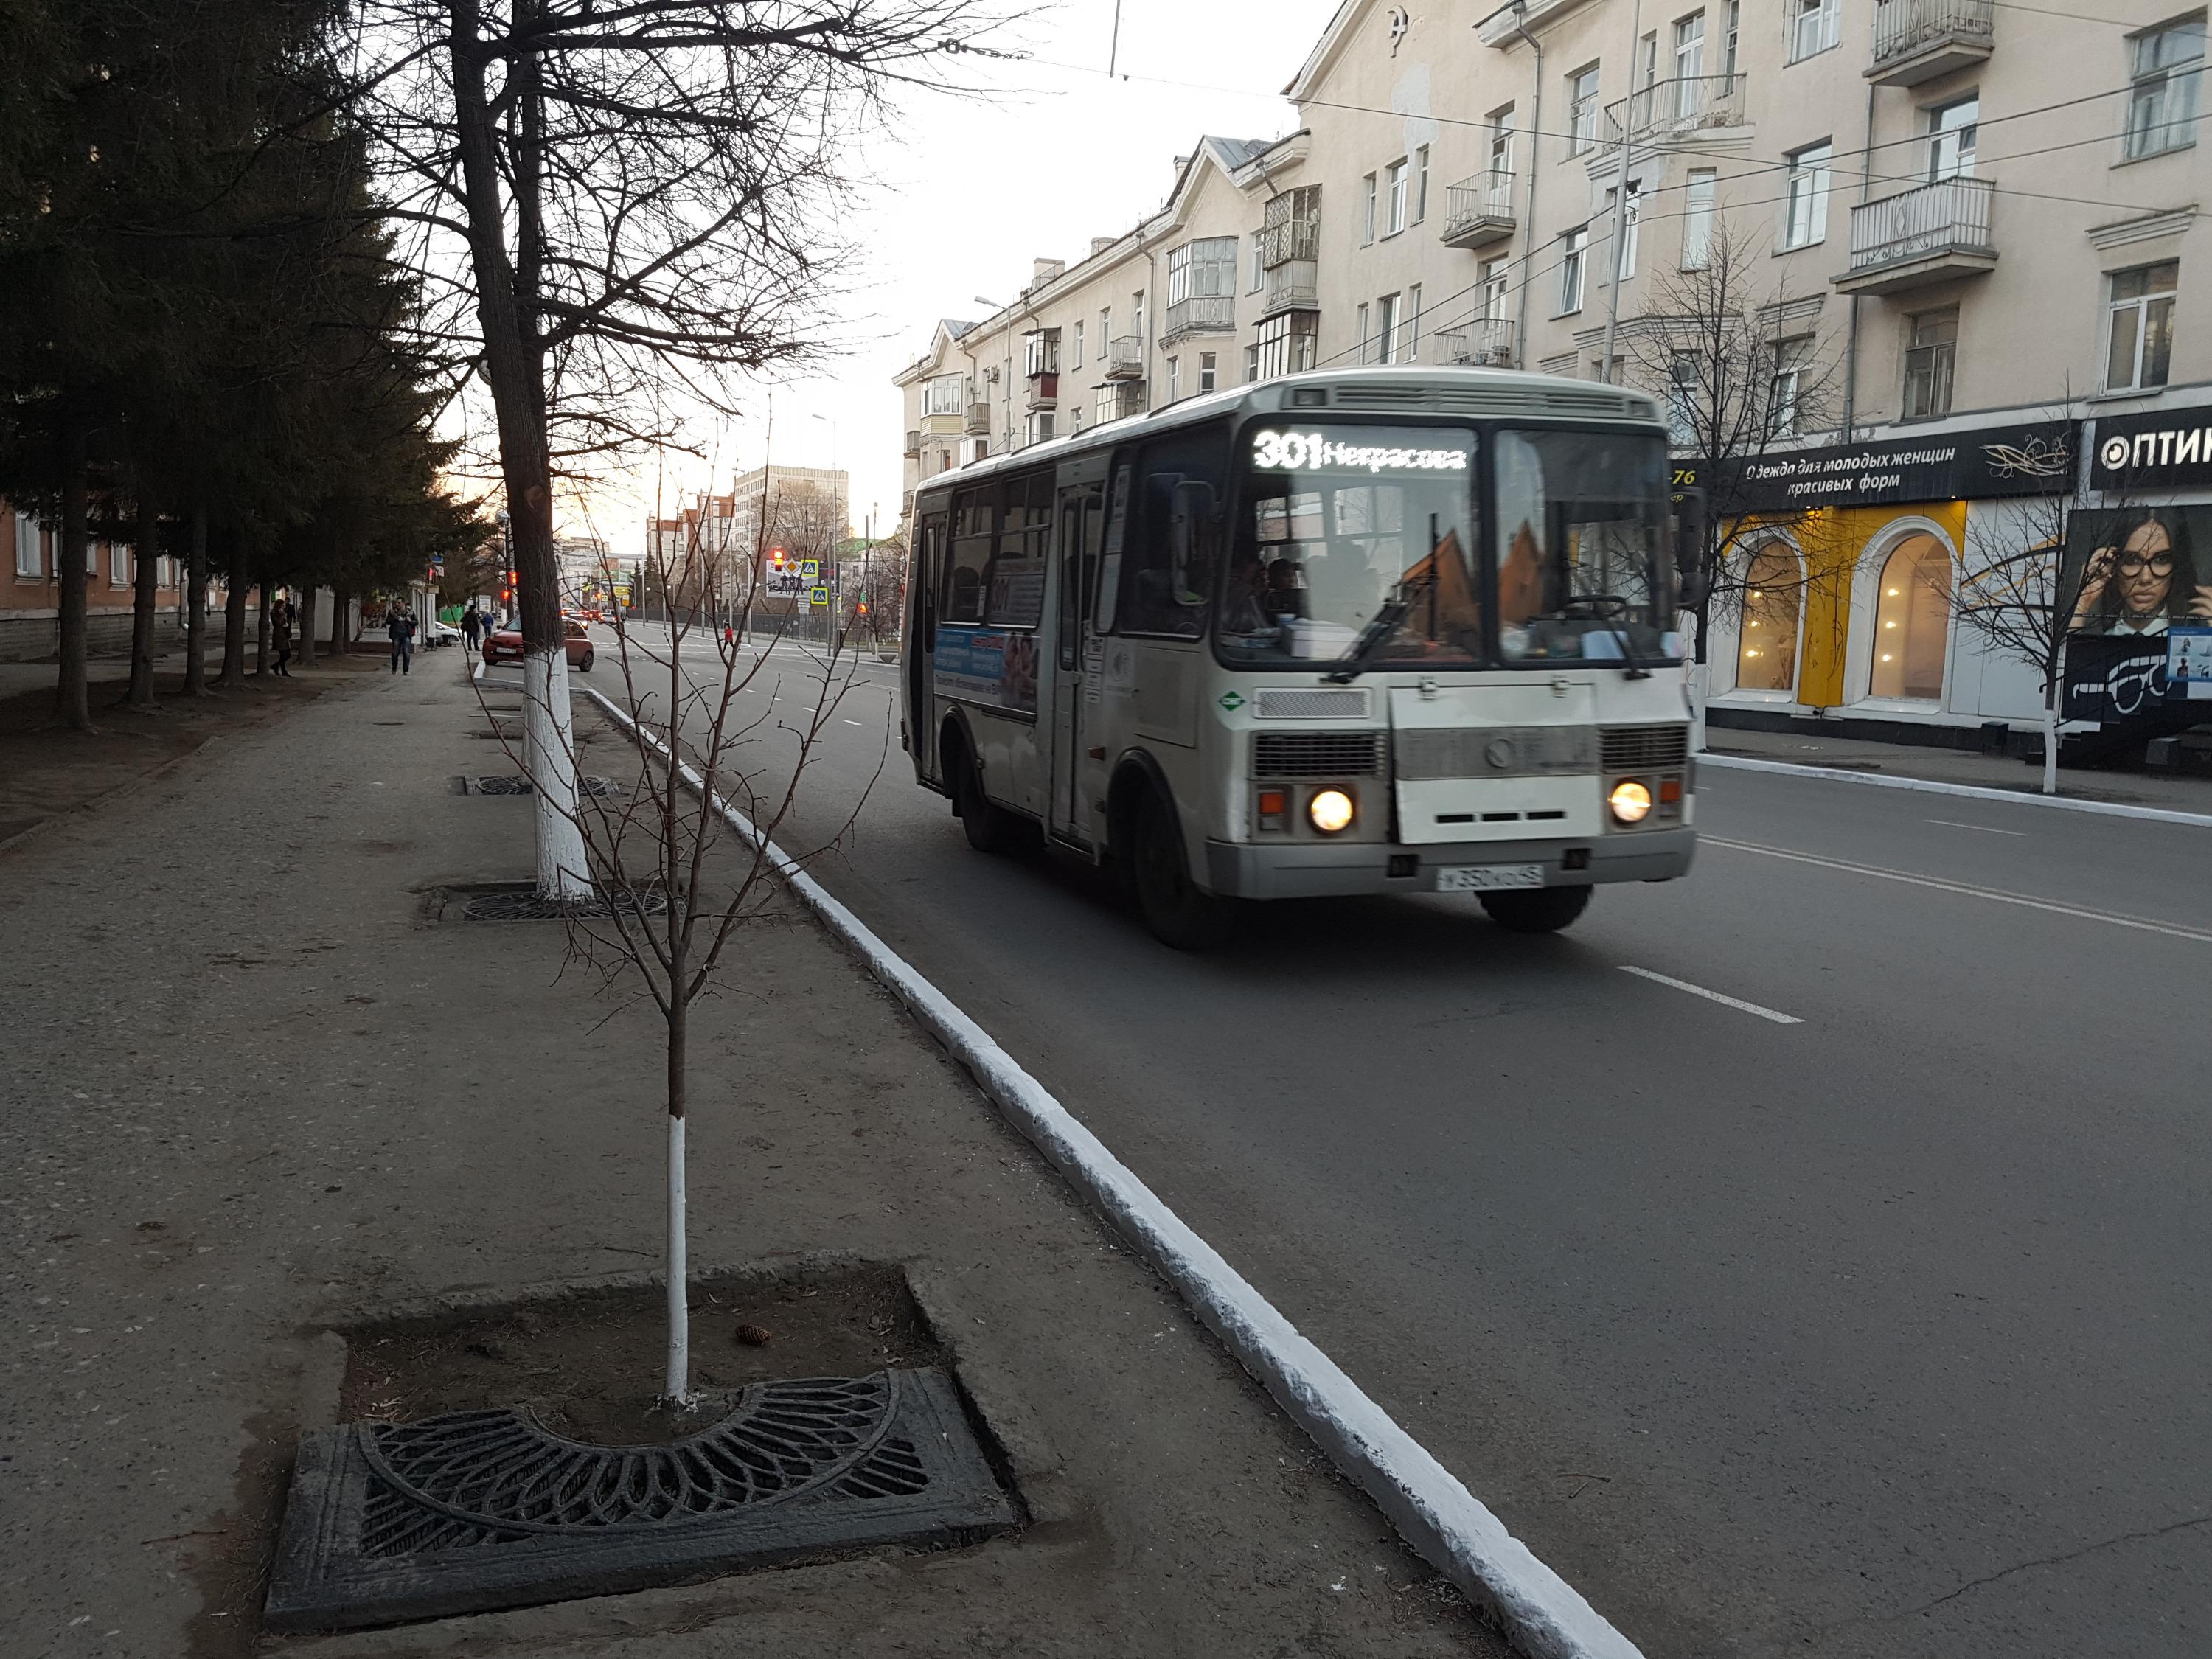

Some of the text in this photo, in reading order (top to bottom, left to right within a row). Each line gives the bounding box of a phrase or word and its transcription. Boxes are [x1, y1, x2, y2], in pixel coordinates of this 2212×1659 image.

[1253, 431, 1323, 469] 301
[1746, 447, 1955, 480] Одежда для молодых женщин
[1787, 472, 1901, 498] красивых форм
